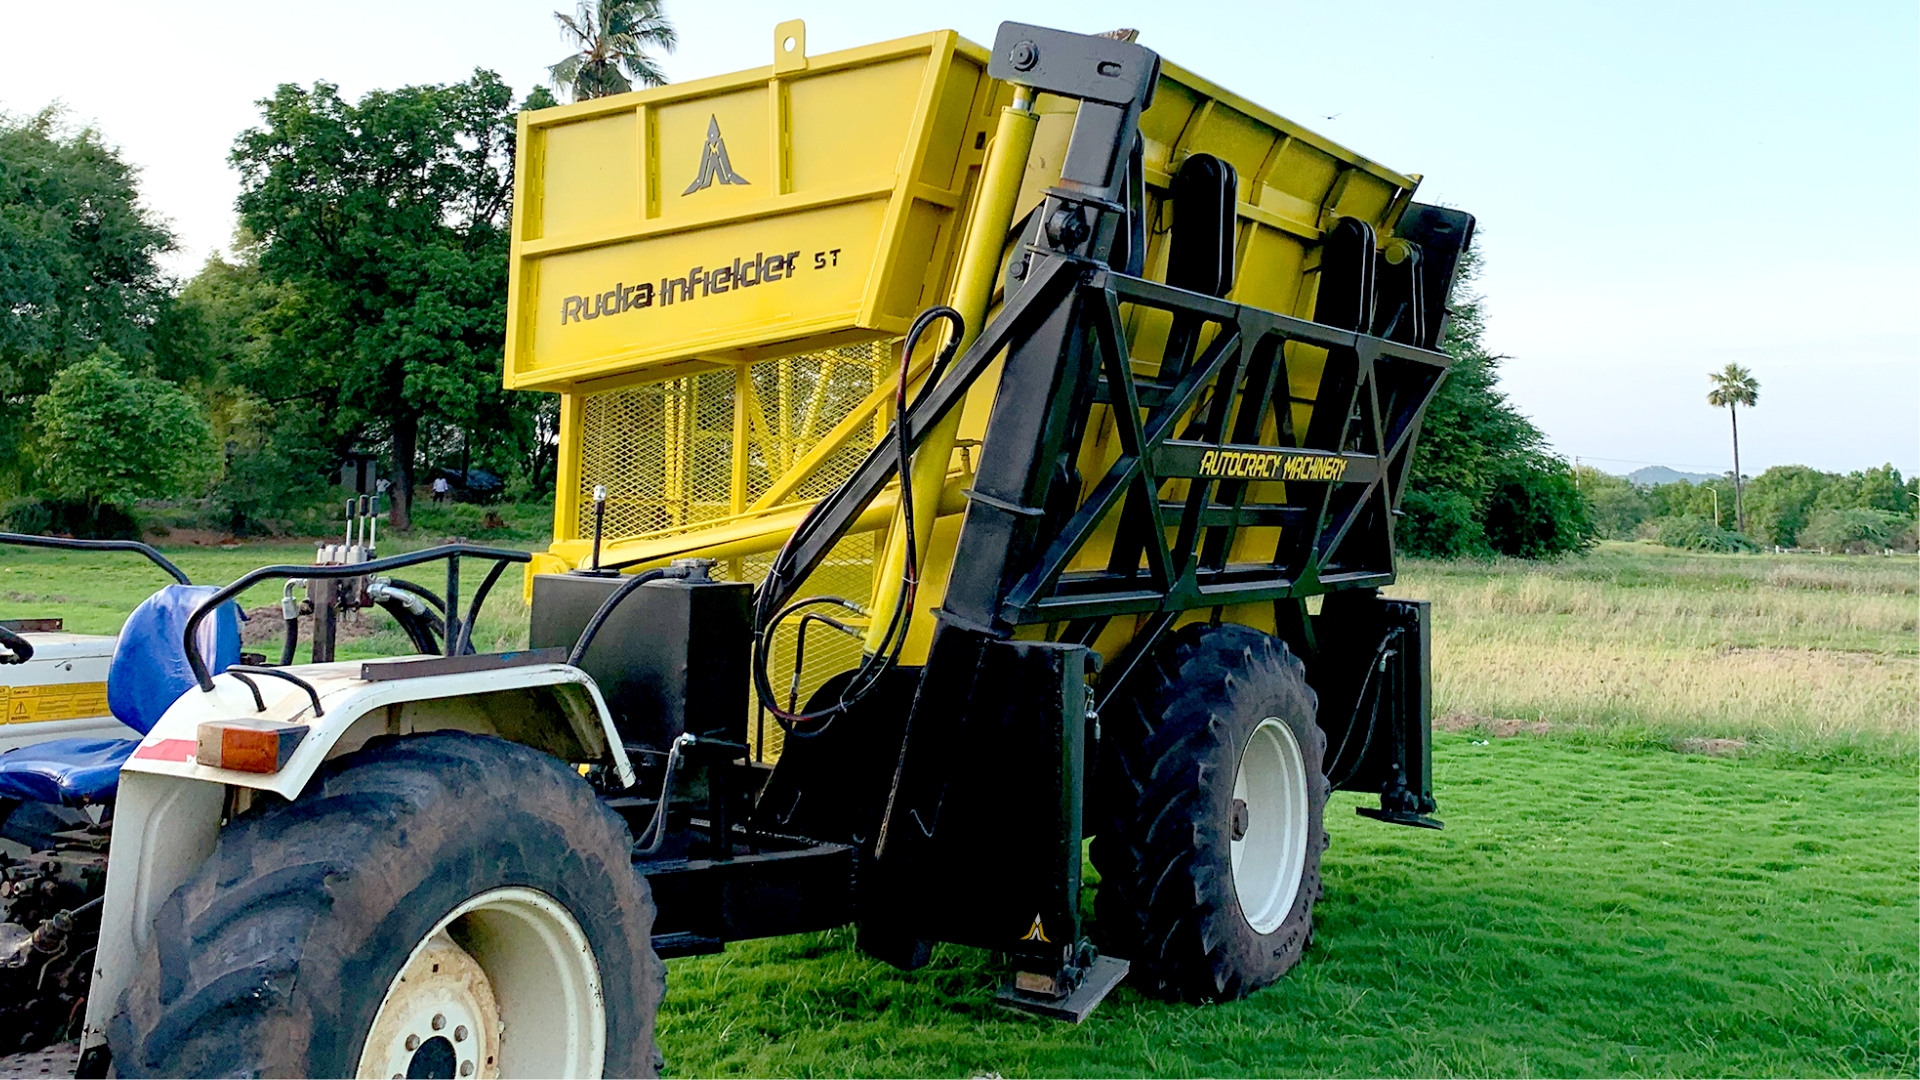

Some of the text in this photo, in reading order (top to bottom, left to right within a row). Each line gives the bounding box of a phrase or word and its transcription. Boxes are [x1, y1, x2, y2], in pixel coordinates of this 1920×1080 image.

[561, 282, 654, 325] Rudra
[659, 250, 800, 307] Infielder
[1199, 450, 1348, 482] AUTOCRACY MACHINERY
